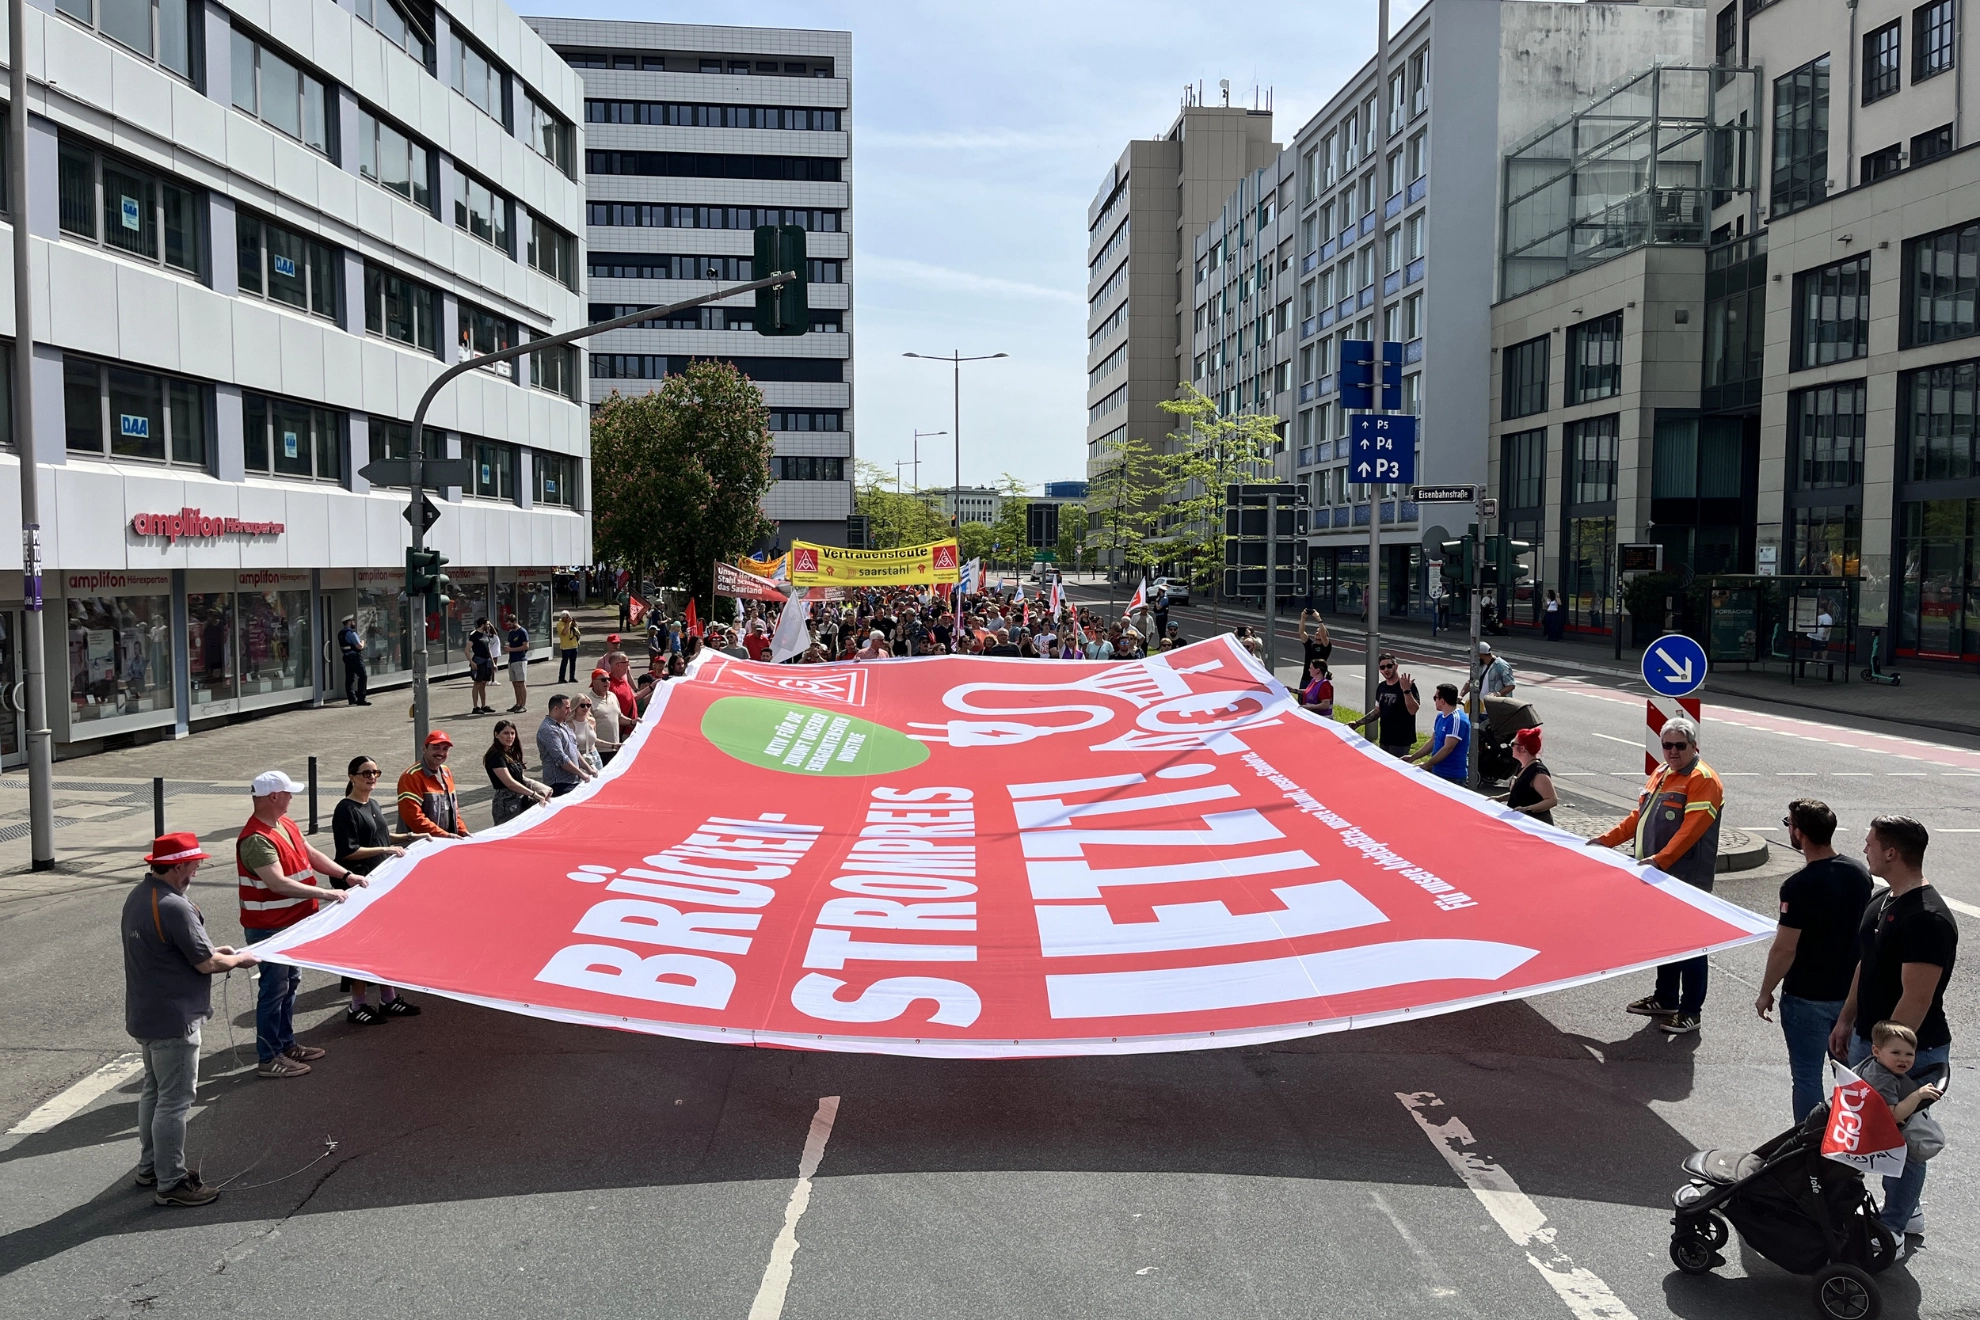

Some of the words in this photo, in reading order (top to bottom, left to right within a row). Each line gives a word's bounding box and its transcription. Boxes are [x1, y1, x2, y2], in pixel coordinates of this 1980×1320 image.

[275, 257, 294, 275] DAA
[122, 416, 148, 436] DAA
[1377, 419, 1389, 429] P5
[1376, 437, 1393, 450] P4
[1376, 458, 1399, 478] P3
[1418, 489, 1469, 500] Eisenbahnstraße
[133, 507, 225, 543] amplifon
[224, 517, 285, 536] Hörexperten
[239, 570, 280, 587] amplifon
[717, 575, 736, 584] Stahl
[718, 567, 738, 577] Unser
[859, 565, 910, 577] saarstahl
[69, 571, 126, 593] amplifon
[127, 575, 168, 586] Hörexperten
[717, 583, 730, 592] das
[731, 585, 763, 595] Saarland
[774, 721, 799, 738] FÜR
[1311, 809, 1352, 830] unsere
[1339, 826, 1416, 870] Arbeitsplätze,
[1398, 867, 1456, 894] unsere
[1006, 763, 1541, 1020] JETZT!
[1433, 891, 1479, 911] Für
[534, 812, 824, 1010] BRÜCKEN-
[791, 786, 982, 1028] STROMPREIS
[1832, 1088, 1865, 1152] DGB
[1810, 1175, 1822, 1194] Joie
